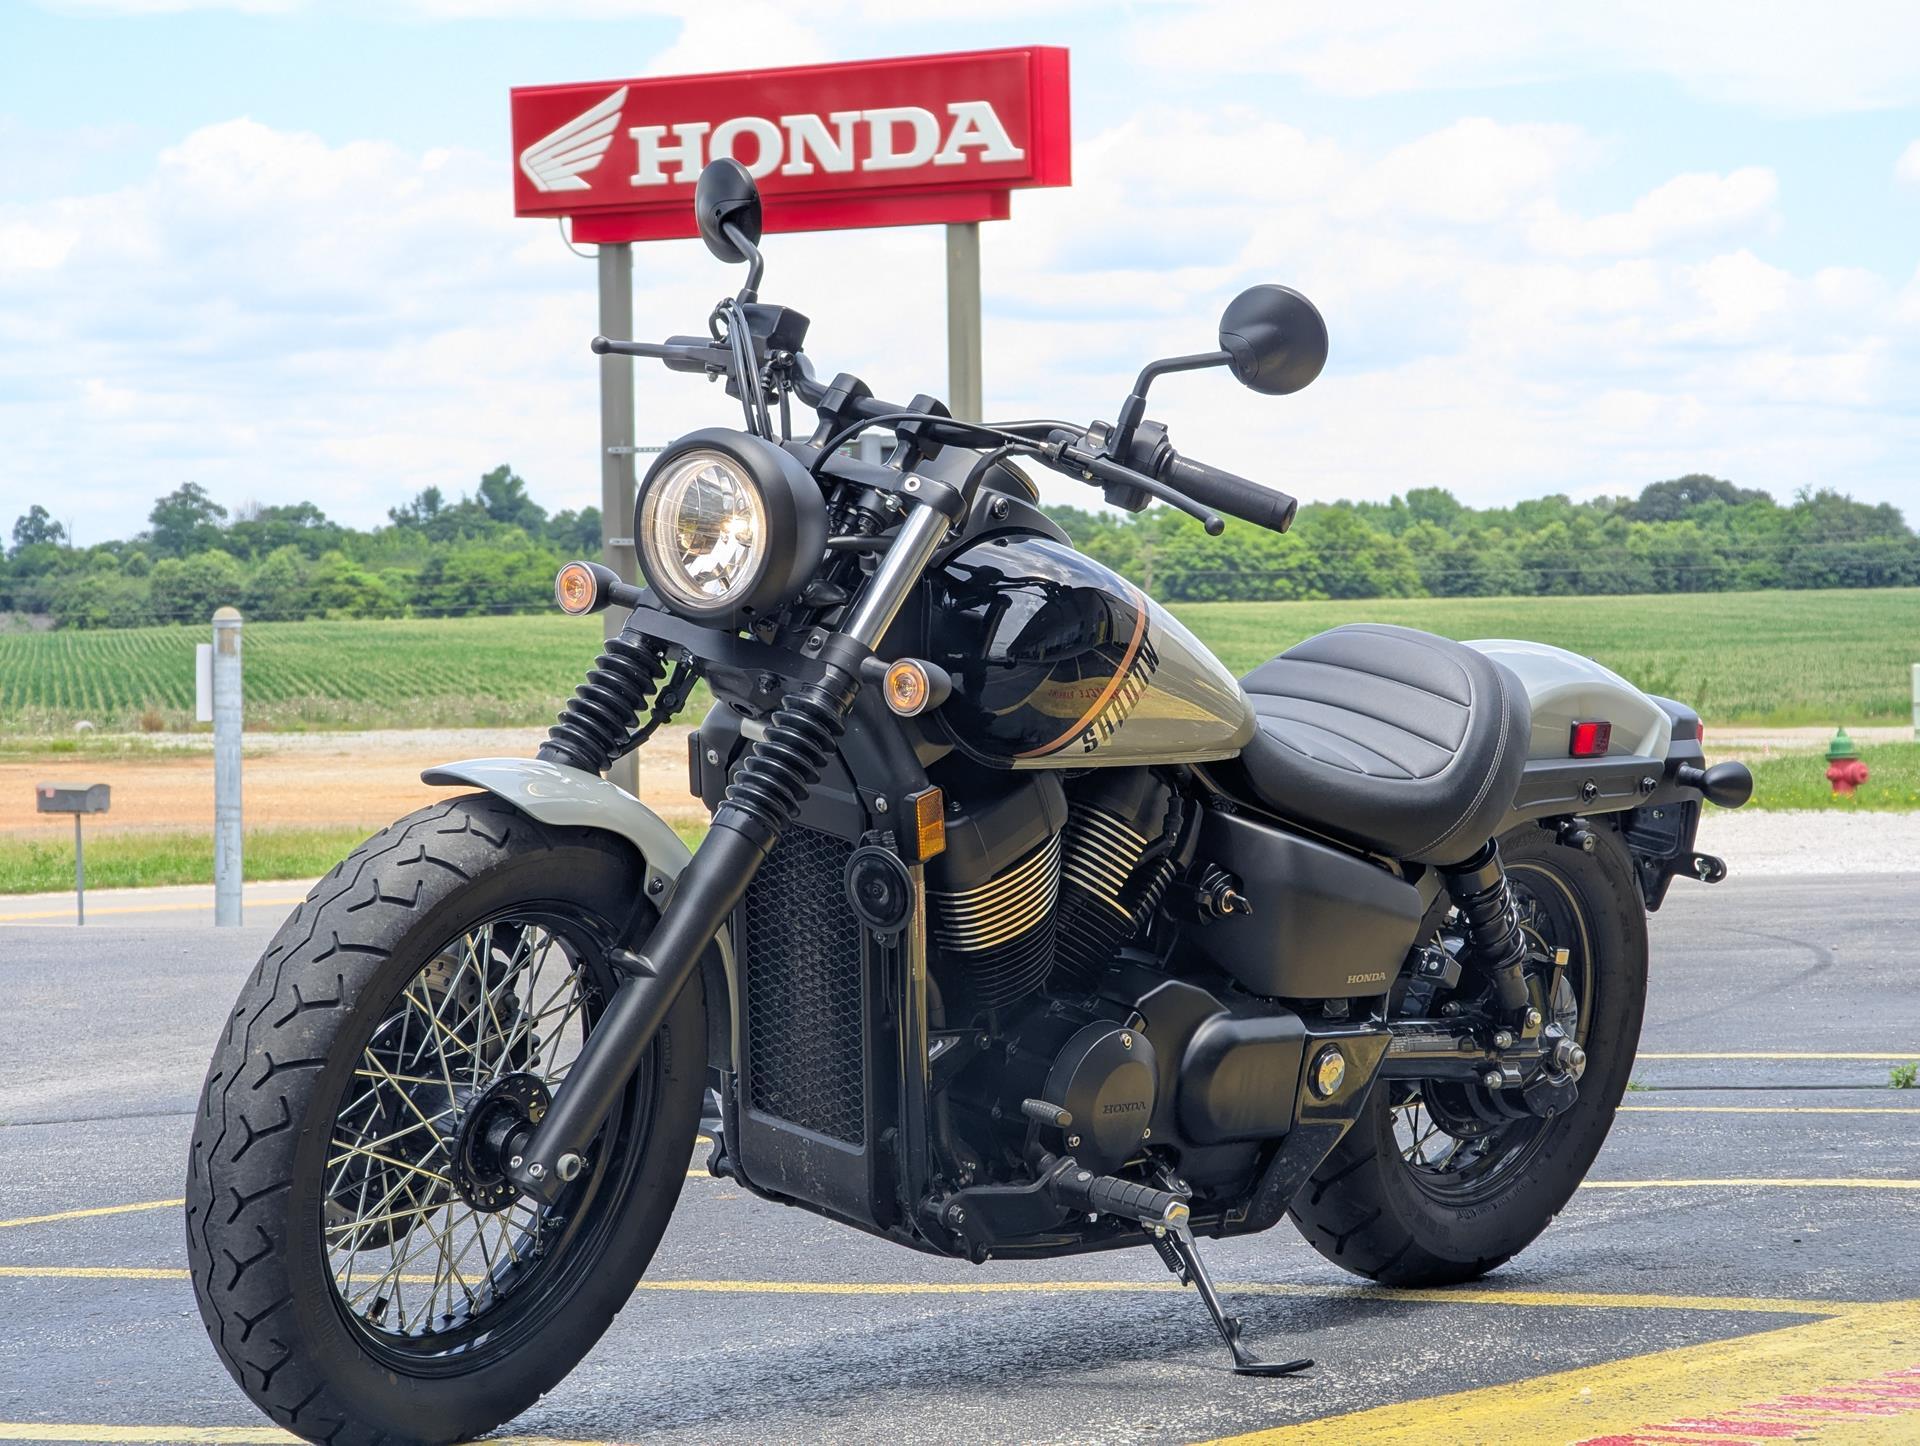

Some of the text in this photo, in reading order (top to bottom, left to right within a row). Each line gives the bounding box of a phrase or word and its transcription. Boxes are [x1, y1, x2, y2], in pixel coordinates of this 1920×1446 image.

[629, 100, 1024, 187] HONDA
[1081, 635, 1160, 753] SHADOW
[1347, 972, 1386, 983] HONDA
[1102, 1101, 1146, 1114] HONDA
